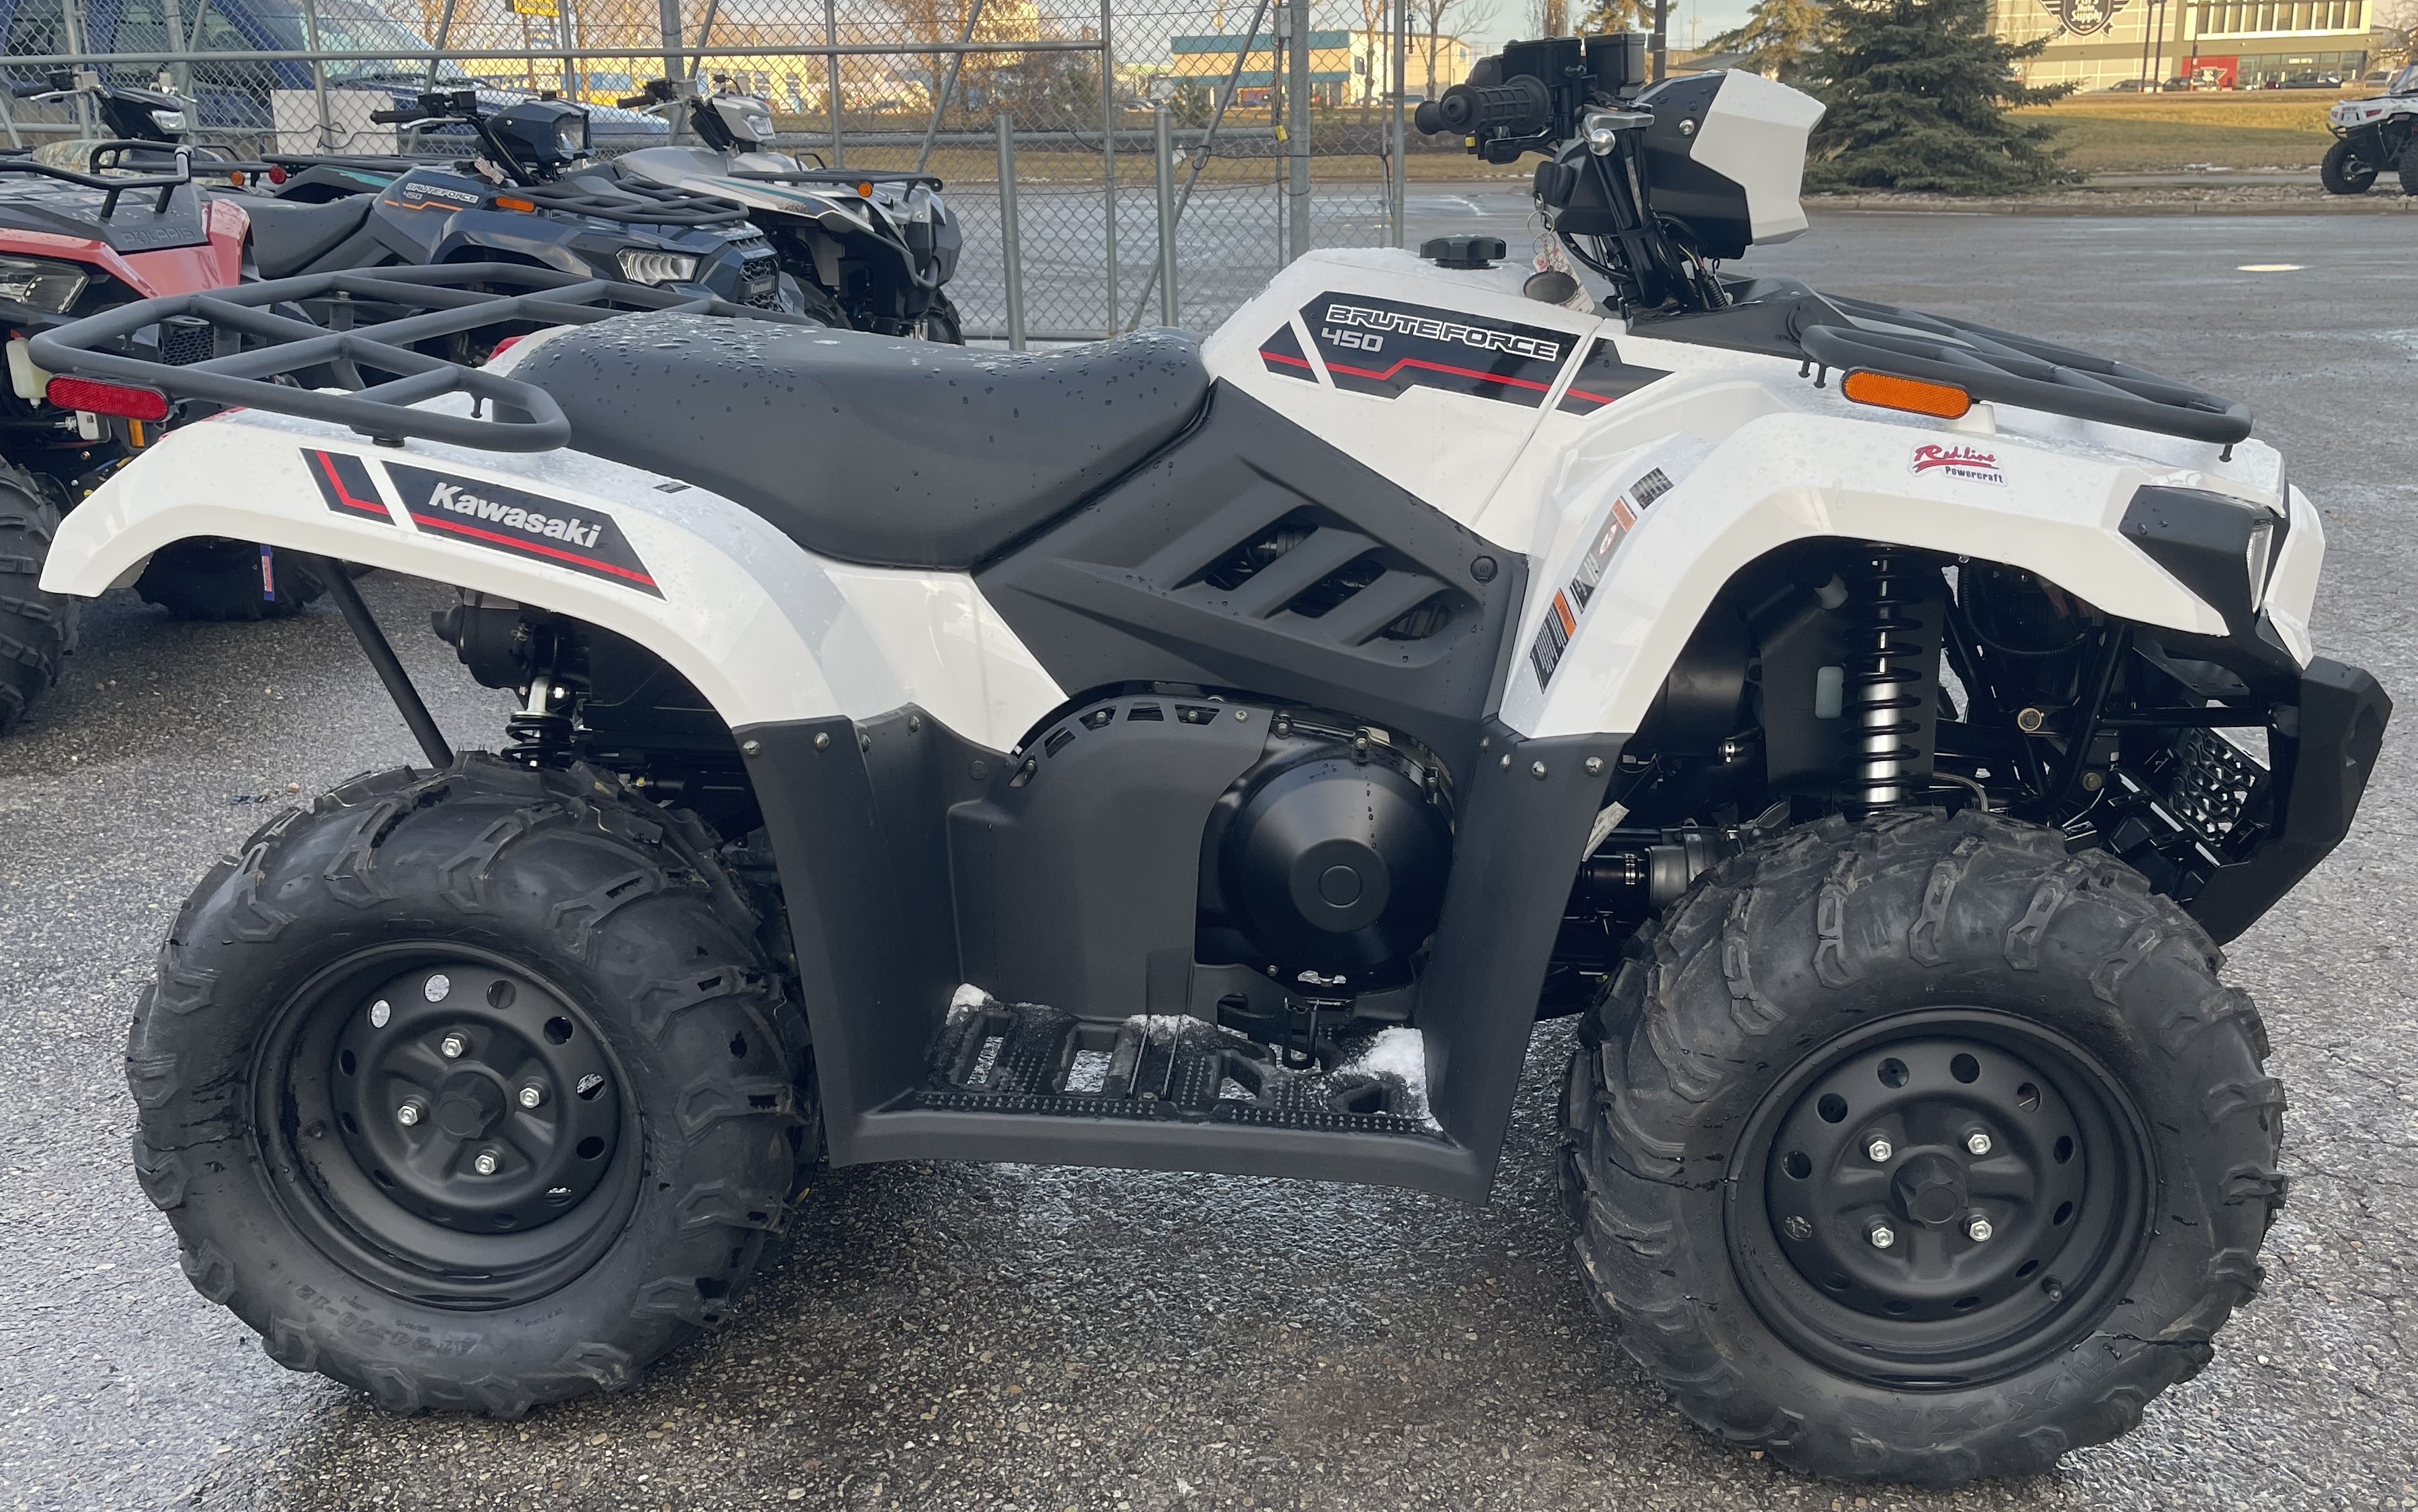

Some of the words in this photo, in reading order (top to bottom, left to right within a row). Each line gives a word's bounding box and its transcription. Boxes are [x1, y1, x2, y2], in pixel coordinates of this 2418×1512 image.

[2071, 10, 2103, 24] Supply
[403, 191, 422, 200] 450
[405, 182, 442, 197] BRUTE
[440, 188, 479, 204] FORCE
[122, 225, 196, 245] POLARIS
[1321, 327, 1384, 352] 450
[1325, 303, 1442, 339] BRUTE
[1440, 322, 1560, 362] FORCE
[1945, 466, 2004, 483] Powercraft
[428, 481, 602, 549] Kawasaki
